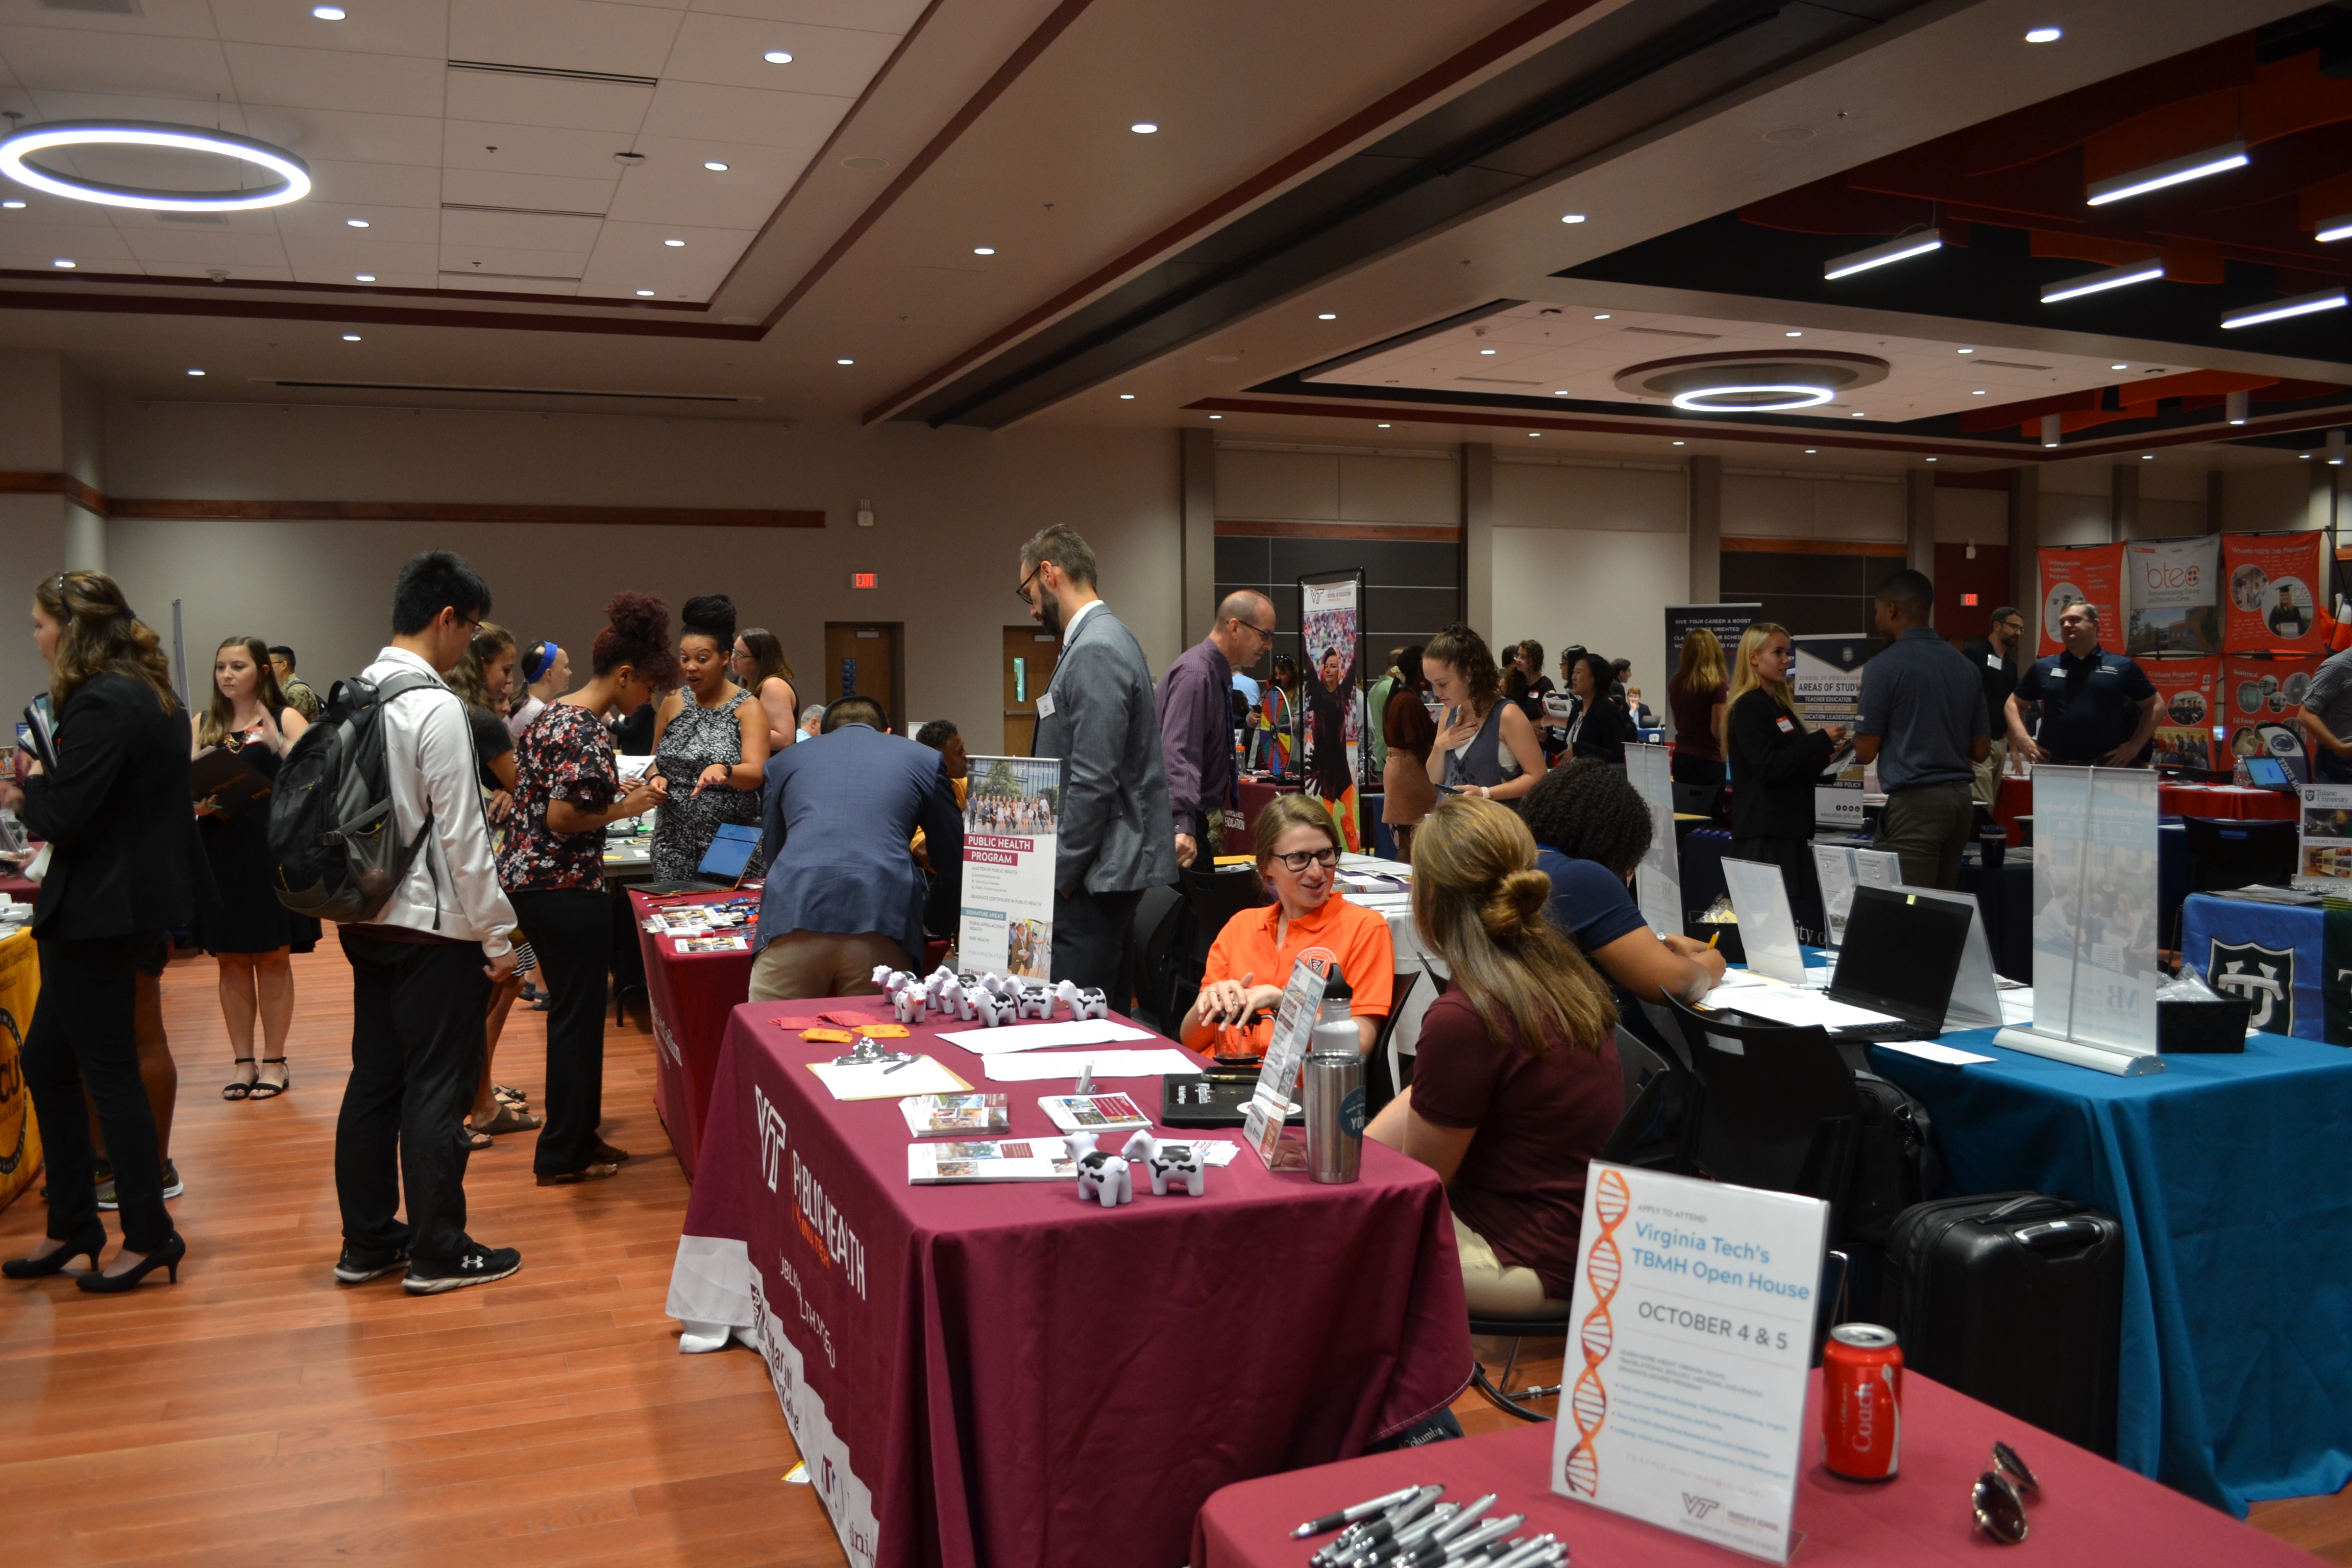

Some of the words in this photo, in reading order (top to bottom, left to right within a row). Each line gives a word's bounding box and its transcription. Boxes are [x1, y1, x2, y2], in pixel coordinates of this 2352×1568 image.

[856, 573, 874, 587] EXIT
[2146, 562, 2200, 589] btec
[1798, 683, 1822, 692] AREAS
[1824, 683, 1833, 691] OF
[968, 836, 996, 847] PUBLIC
[998, 839, 1031, 850] HEALTH
[971, 851, 1012, 864] PROGRAM
[966, 909, 988, 918] SIGNATURE
[755, 1084, 787, 1194] VT
[1637, 1204, 1661, 1214] APPLY
[1662, 1208, 1674, 1217] TO
[1675, 1211, 1706, 1223] ATTEND
[1635, 1221, 1706, 1250] Virginia
[1712, 1237, 1770, 1264] Tech's
[1632, 1247, 1688, 1275] TBMH
[1692, 1261, 1743, 1286] Open
[1748, 1272, 1809, 1300] House
[1638, 1301, 1731, 1337] OCTOBER
[1737, 1325, 1749, 1341] 4
[1755, 1328, 1770, 1347] &
[1776, 1333, 1788, 1351] 5
[1851, 1383, 1874, 1452] Coach
[1682, 1492, 1720, 1519] VT
